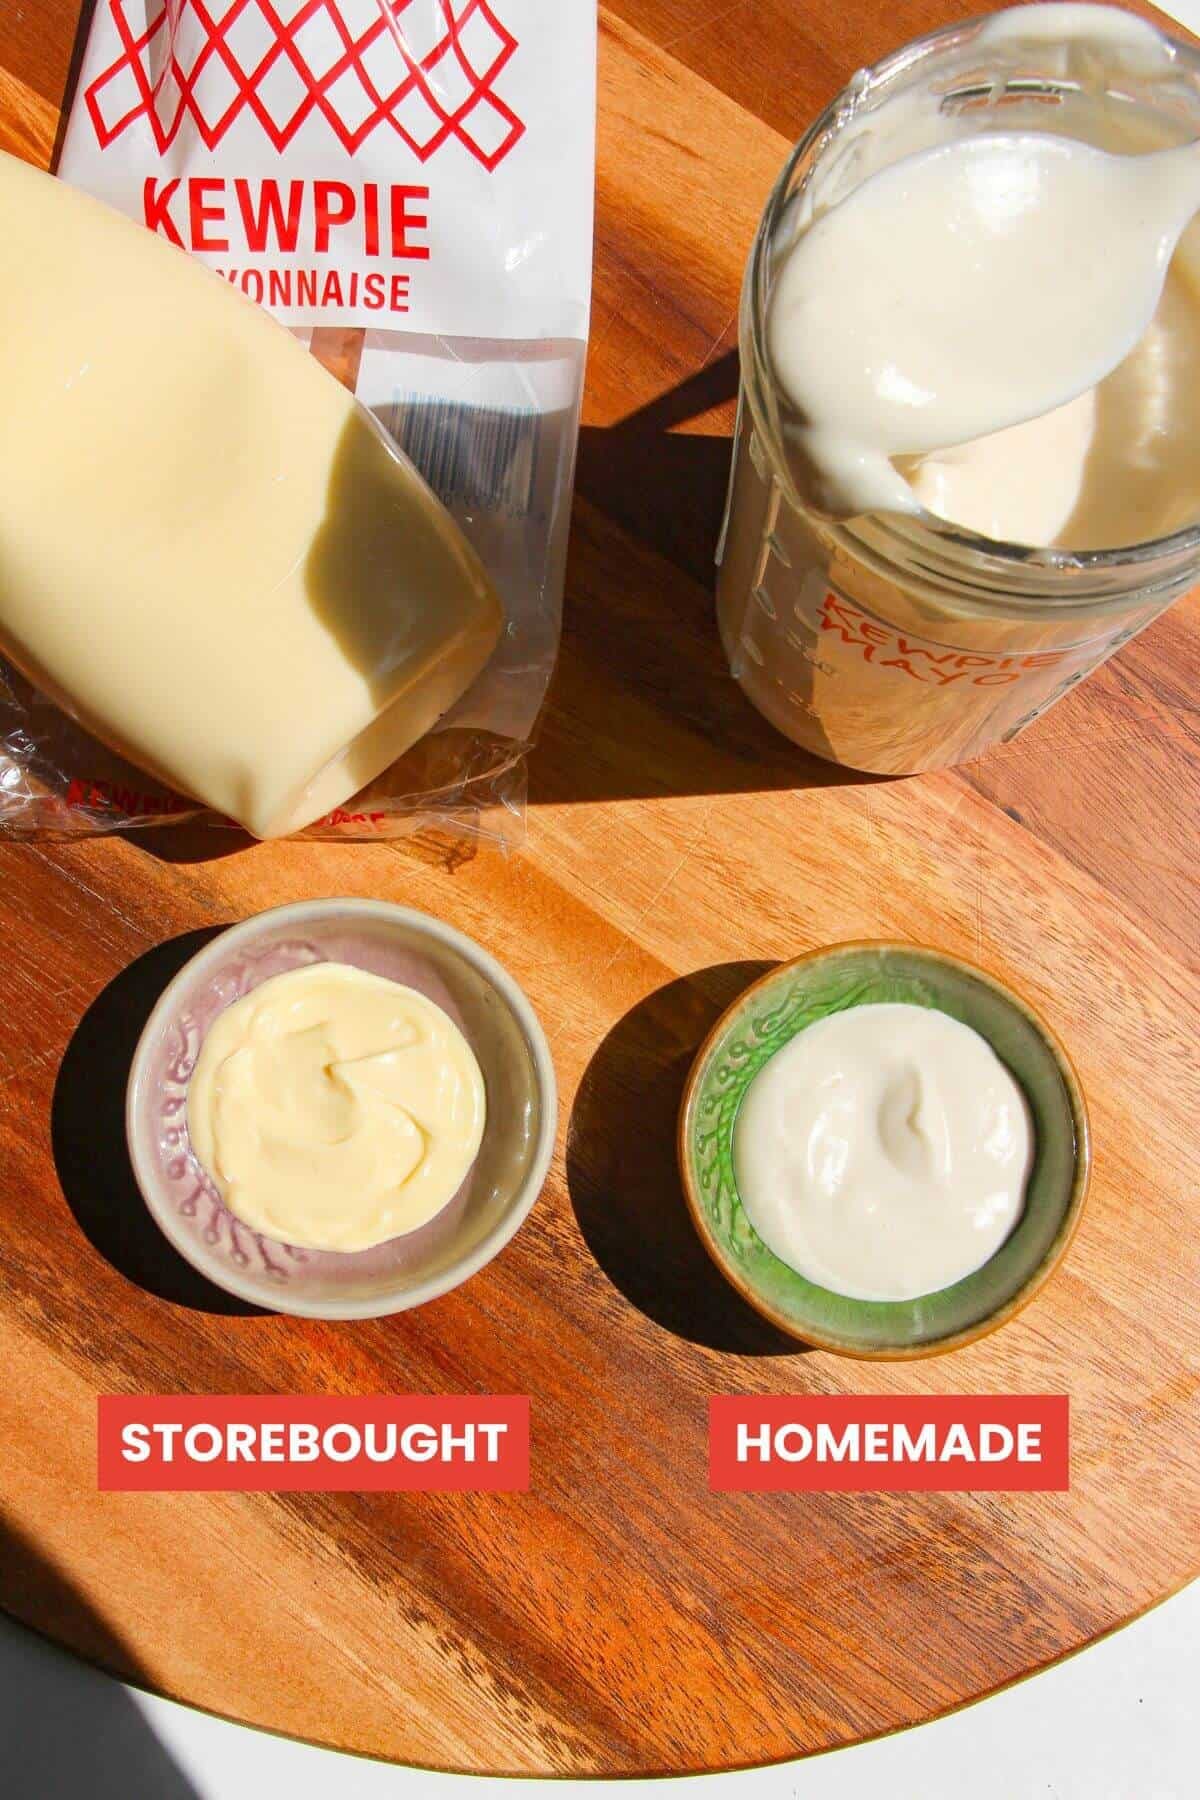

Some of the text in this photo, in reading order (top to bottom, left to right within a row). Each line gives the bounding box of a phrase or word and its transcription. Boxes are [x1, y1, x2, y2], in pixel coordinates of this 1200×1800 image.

[143, 177, 430, 260] KEWPIE
[816, 608, 1020, 686] MAYO
[823, 592, 1072, 669] KEWPIE
